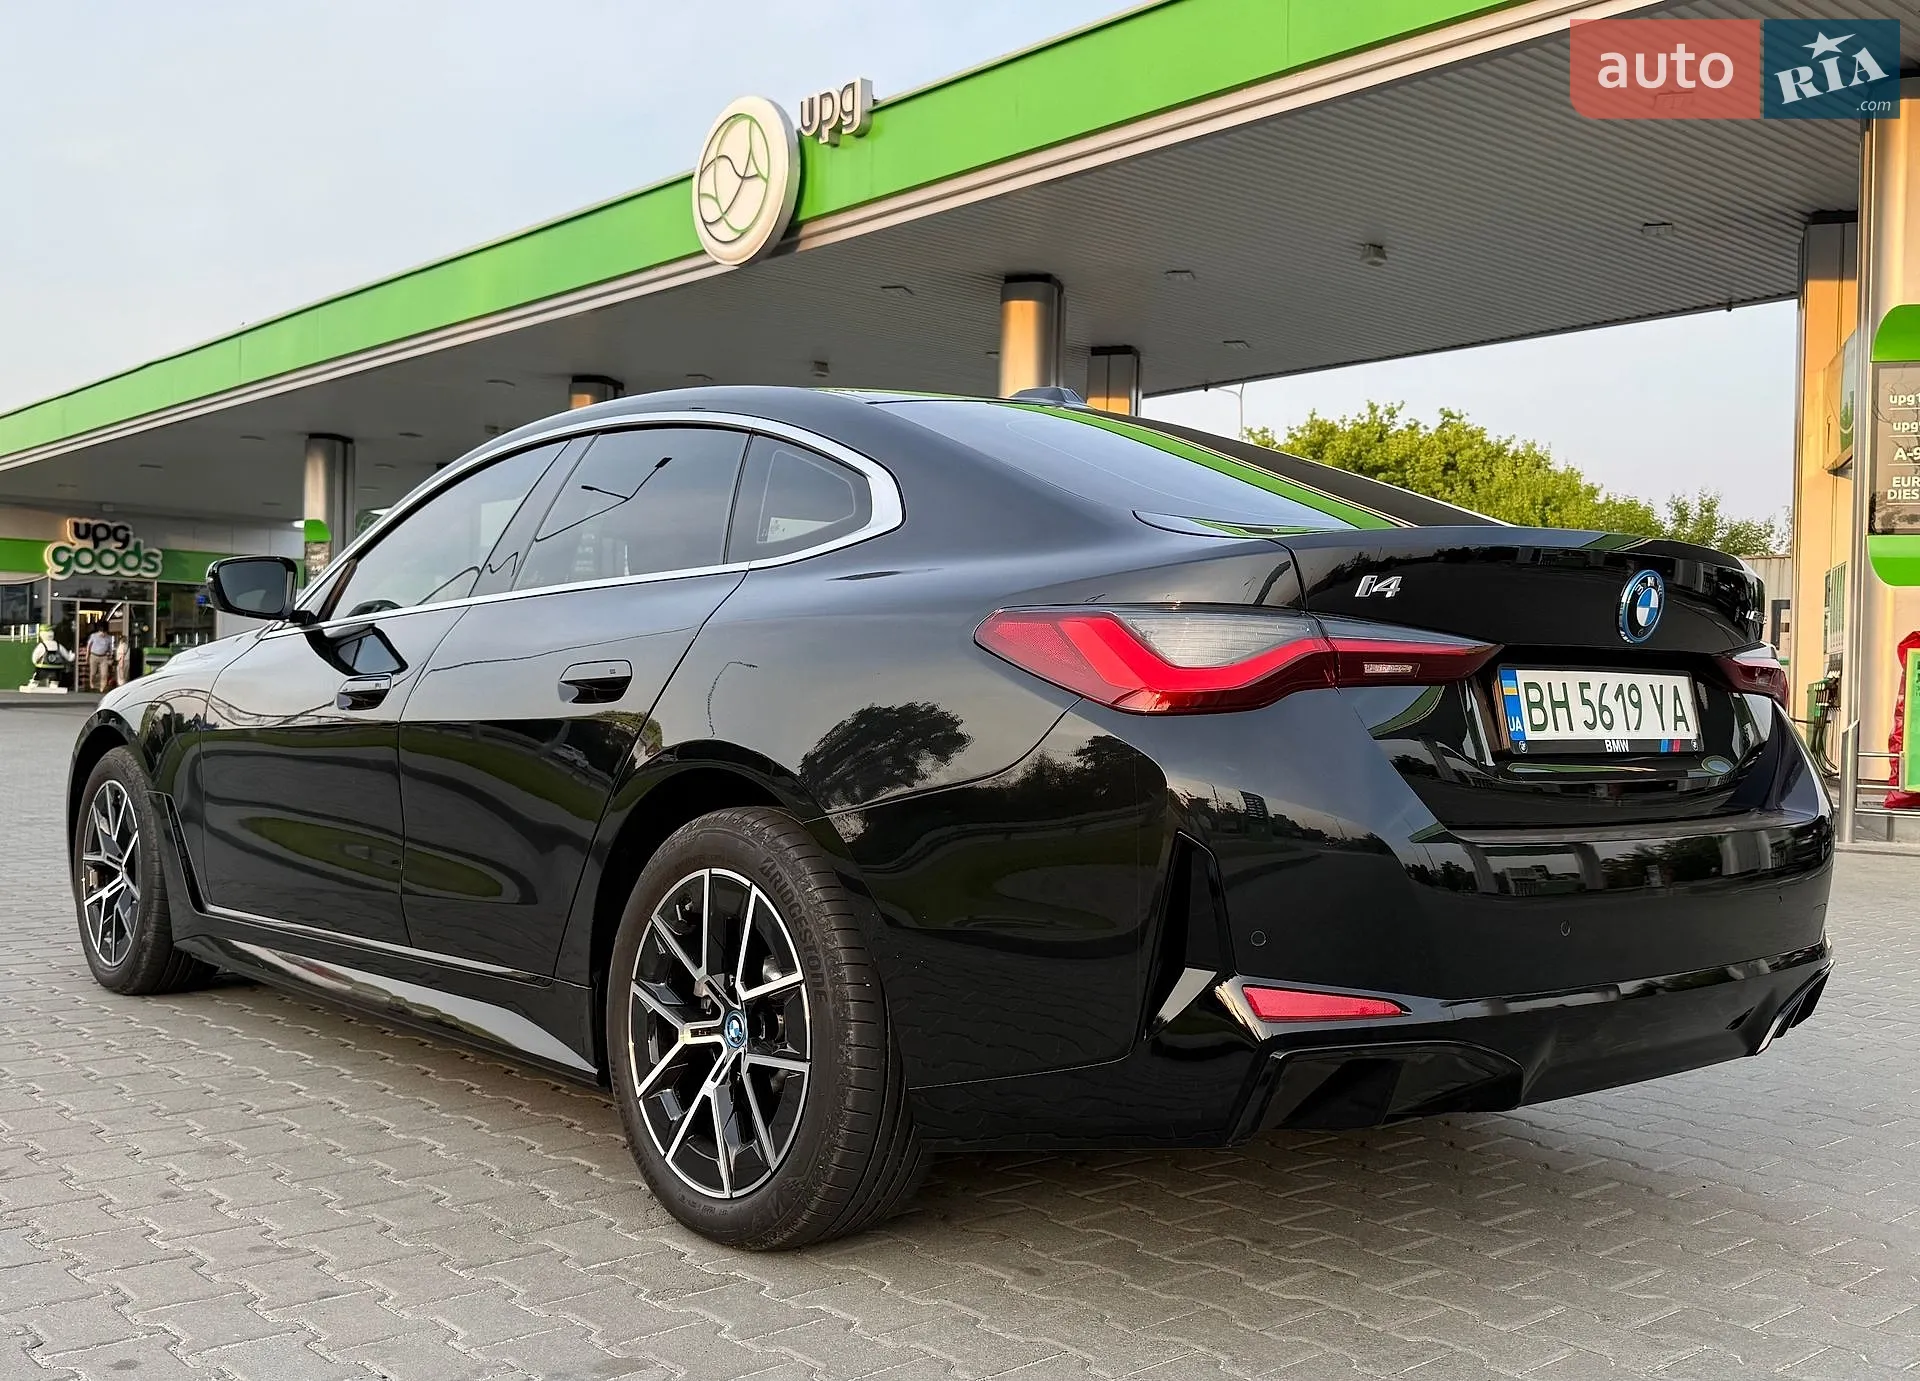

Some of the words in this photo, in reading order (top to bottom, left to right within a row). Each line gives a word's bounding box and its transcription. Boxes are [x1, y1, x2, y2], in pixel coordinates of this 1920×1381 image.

[800, 78, 863, 145] upg
[1892, 421, 1920, 433] upg
[73, 521, 132, 549] upg
[51, 540, 160, 575] goods
[1354, 575, 1403, 598] i4
[1523, 682, 1574, 732] BH
[1578, 682, 1642, 731] 5619
[1649, 684, 1690, 732] YA
[1508, 715, 1523, 732] UA
[1604, 739, 1630, 753] BMW
